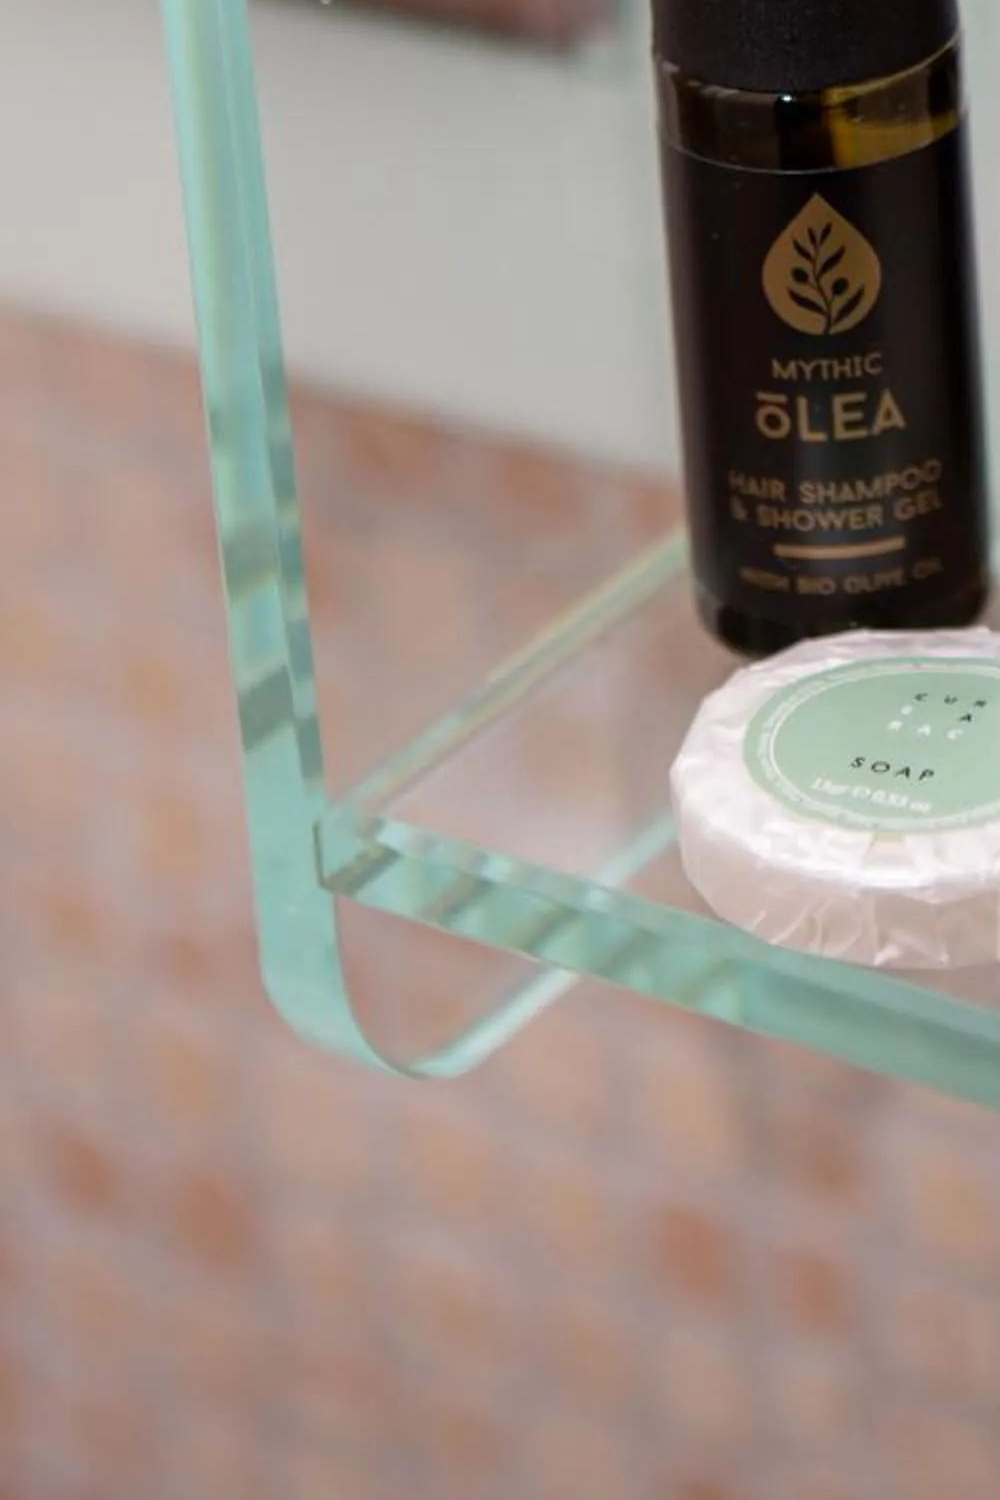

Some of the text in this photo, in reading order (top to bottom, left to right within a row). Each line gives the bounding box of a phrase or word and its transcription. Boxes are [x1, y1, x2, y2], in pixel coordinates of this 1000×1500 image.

[771, 352, 883, 380] MYTHIC
[728, 457, 943, 505] HAIR SHAMPOO
[756, 504, 884, 532] SHOWER
[893, 489, 944, 521] GEL
[849, 756, 936, 781] SOAP
